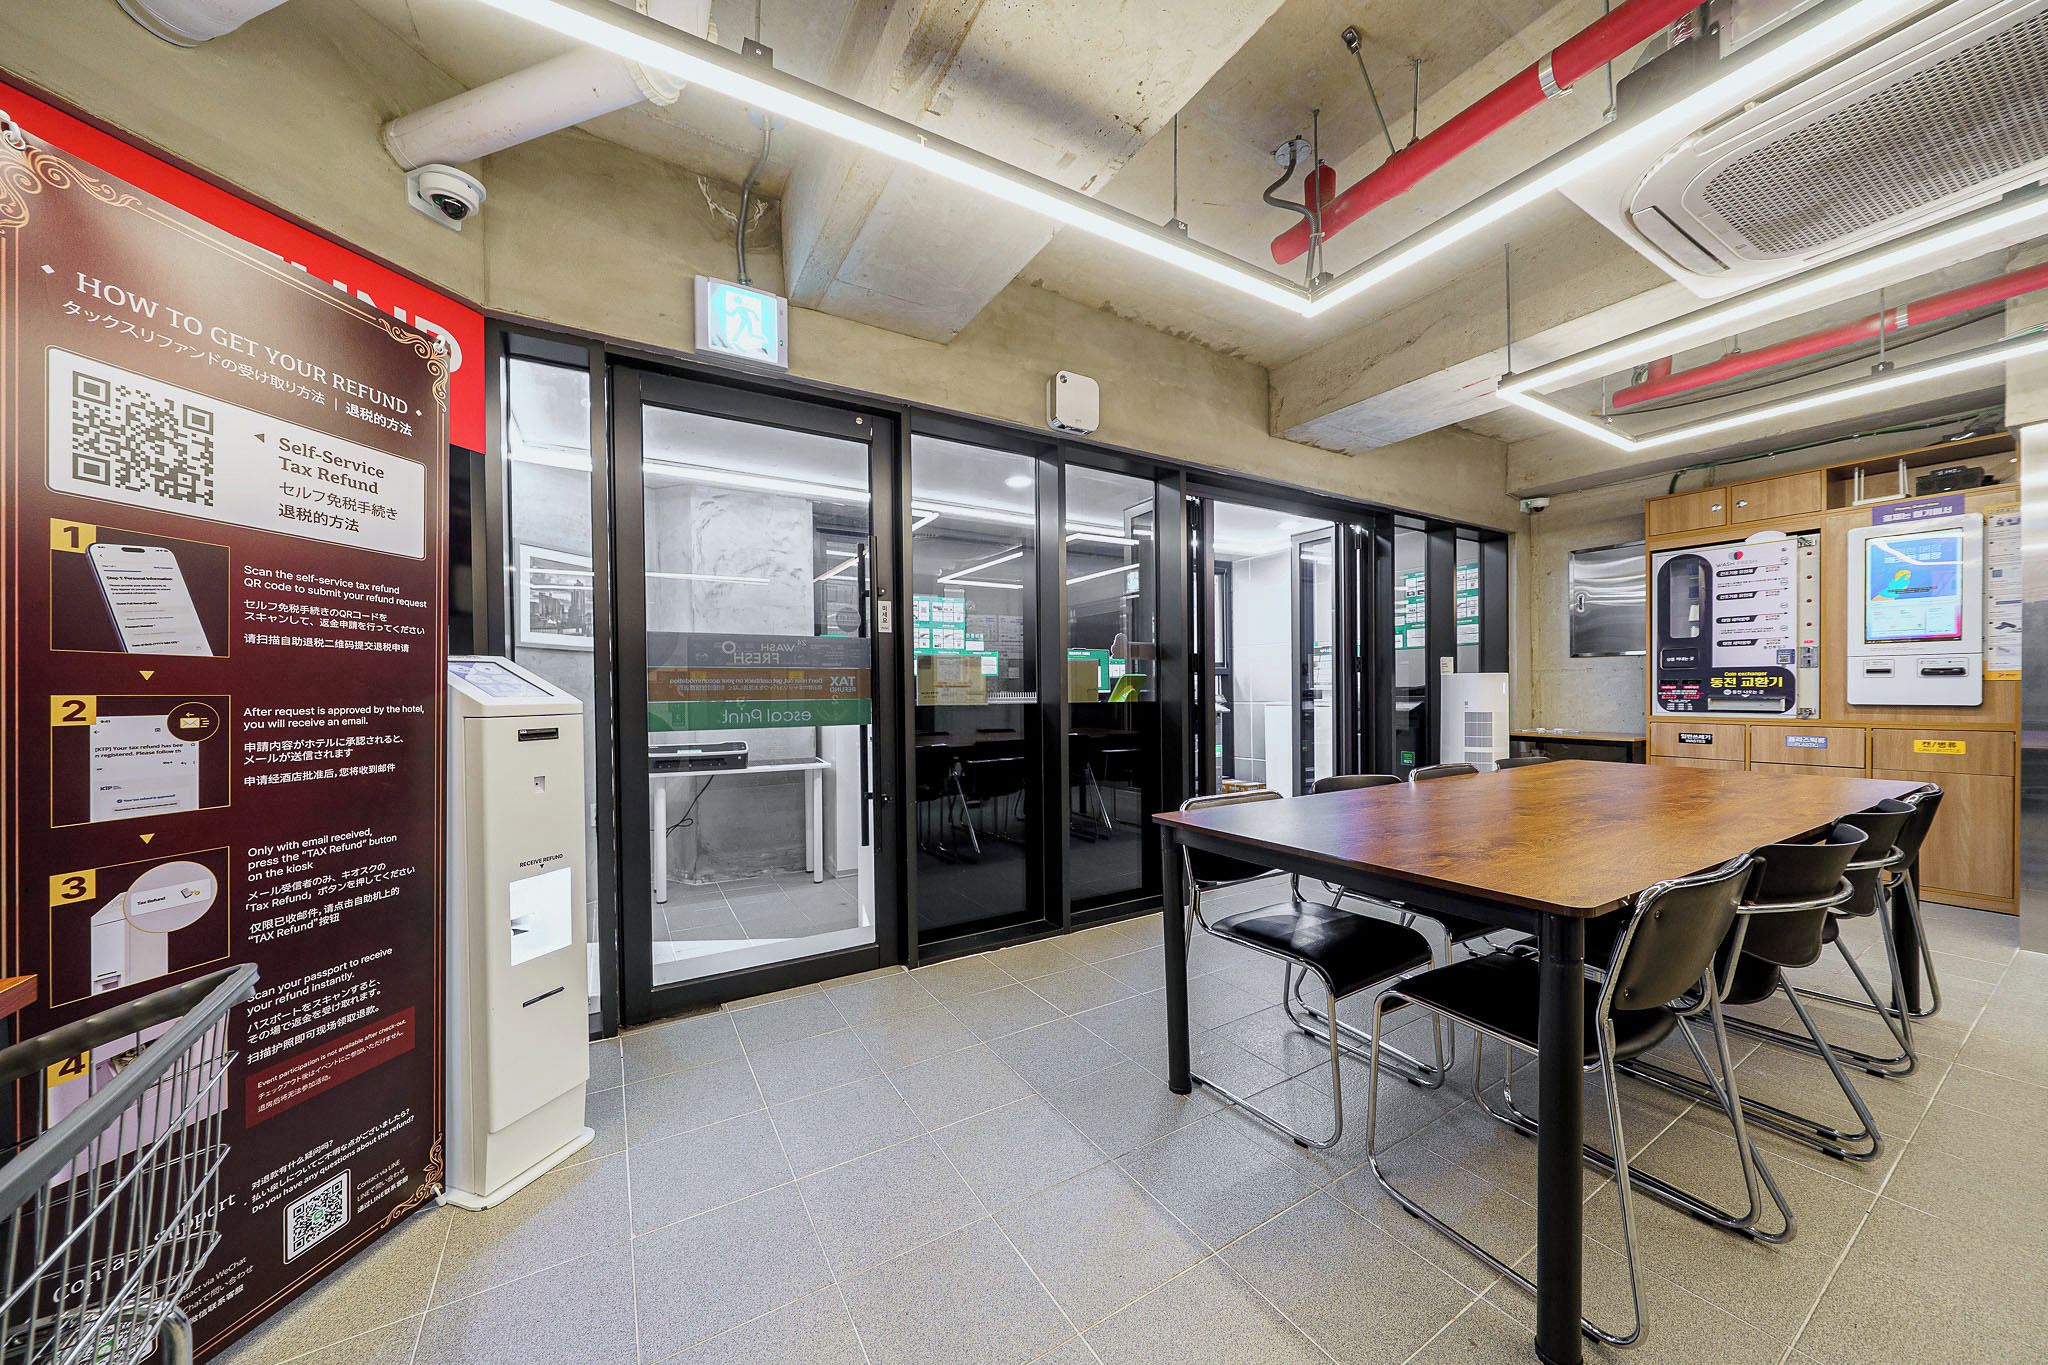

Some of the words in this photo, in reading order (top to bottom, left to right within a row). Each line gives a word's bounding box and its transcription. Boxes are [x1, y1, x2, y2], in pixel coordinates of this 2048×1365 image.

[62, 301, 325, 405] タックスリファンドの受け取り方法
[76, 272, 159, 318] HOW
[166, 307, 202, 335] TO
[211, 327, 258, 357] GET
[264, 346, 327, 386] YOUR
[332, 373, 407, 416] REFUND
[346, 402, 412, 438] 退税的方法
[279, 438, 384, 478] Self-Service
[278, 456, 312, 477] Tax
[318, 467, 379, 495] Refund
[280, 482, 398, 520] セルフ免税手続き
[279, 504, 360, 534] 退税的方法
[63, 526, 80, 548] 1
[244, 565, 272, 577] Scan
[276, 569, 293, 581] the
[296, 573, 353, 588] self-service
[356, 582, 369, 591] tax
[372, 582, 400, 595] refund
[244, 578, 261, 589] QR
[264, 581, 291, 592] code
[295, 585, 305, 594] to
[308, 586, 341, 599] submit
[343, 592, 364, 602] your
[366, 593, 394, 606] refund
[396, 597, 427, 611] request
[244, 600, 388, 622] セルフ免税手続きのQRコードを
[244, 634, 410, 653] 请扫描自助退税二维码提交退税申请
[1710, 677, 1737, 688] 동전
[1740, 676, 1783, 687] 교환기
[61, 700, 86, 723] 2
[244, 707, 272, 717] After
[275, 707, 314, 718] request
[318, 706, 325, 715] is
[328, 705, 371, 716] approved
[373, 704, 384, 716] by
[387, 704, 400, 714] the
[402, 704, 424, 715] hotel,
[244, 721, 265, 731] you
[268, 719, 285, 728] will
[288, 718, 325, 727] receive
[342, 717, 368, 726] email.
[244, 734, 404, 753] 申請内容がホテルに承認されると、
[244, 748, 353, 765] メールが送信されます
[248, 846, 273, 859] Only
[277, 840, 300, 852] with
[302, 834, 328, 848] email
[331, 827, 373, 842] received,
[248, 858, 279, 872] press
[282, 852, 299, 864] the
[369, 834, 397, 848] button
[248, 873, 263, 882] on
[266, 868, 283, 880] the
[286, 861, 314, 876] kiosk
[520, 857, 542, 869] RECEIVE
[544, 853, 564, 864] REFUND
[61, 877, 86, 899] 3
[278, 979, 302, 996] your
[304, 963, 347, 986] passport
[350, 958, 359, 967] to
[361, 947, 392, 963] receive
[246, 1003, 273, 1018] your
[275, 988, 309, 1008] refund
[312, 971, 355, 994] instantly.
[59, 1057, 85, 1078] 4
[257, 1074, 278, 1090] Event
[279, 1057, 320, 1082] participation
[321, 1054, 326, 1062] is
[327, 1049, 337, 1060] not
[338, 1037, 364, 1056] available
[365, 1031, 378, 1044] after
[252, 1202, 264, 1214] Do
[265, 1193, 282, 1209] you
[283, 1182, 303, 1197] have
[304, 1174, 319, 1190] any
[320, 1150, 356, 1178] questions
[357, 1137, 377, 1155] about
[378, 1130, 389, 1142] the
[390, 1114, 415, 1134] refund?
[357, 1175, 379, 1191] Contact
[379, 1170, 388, 1180] via
[388, 1158, 401, 1174] LINE
[176, 1285, 202, 1306] ontact
[203, 1278, 214, 1288] via
[216, 1256, 247, 1280] WeChat
